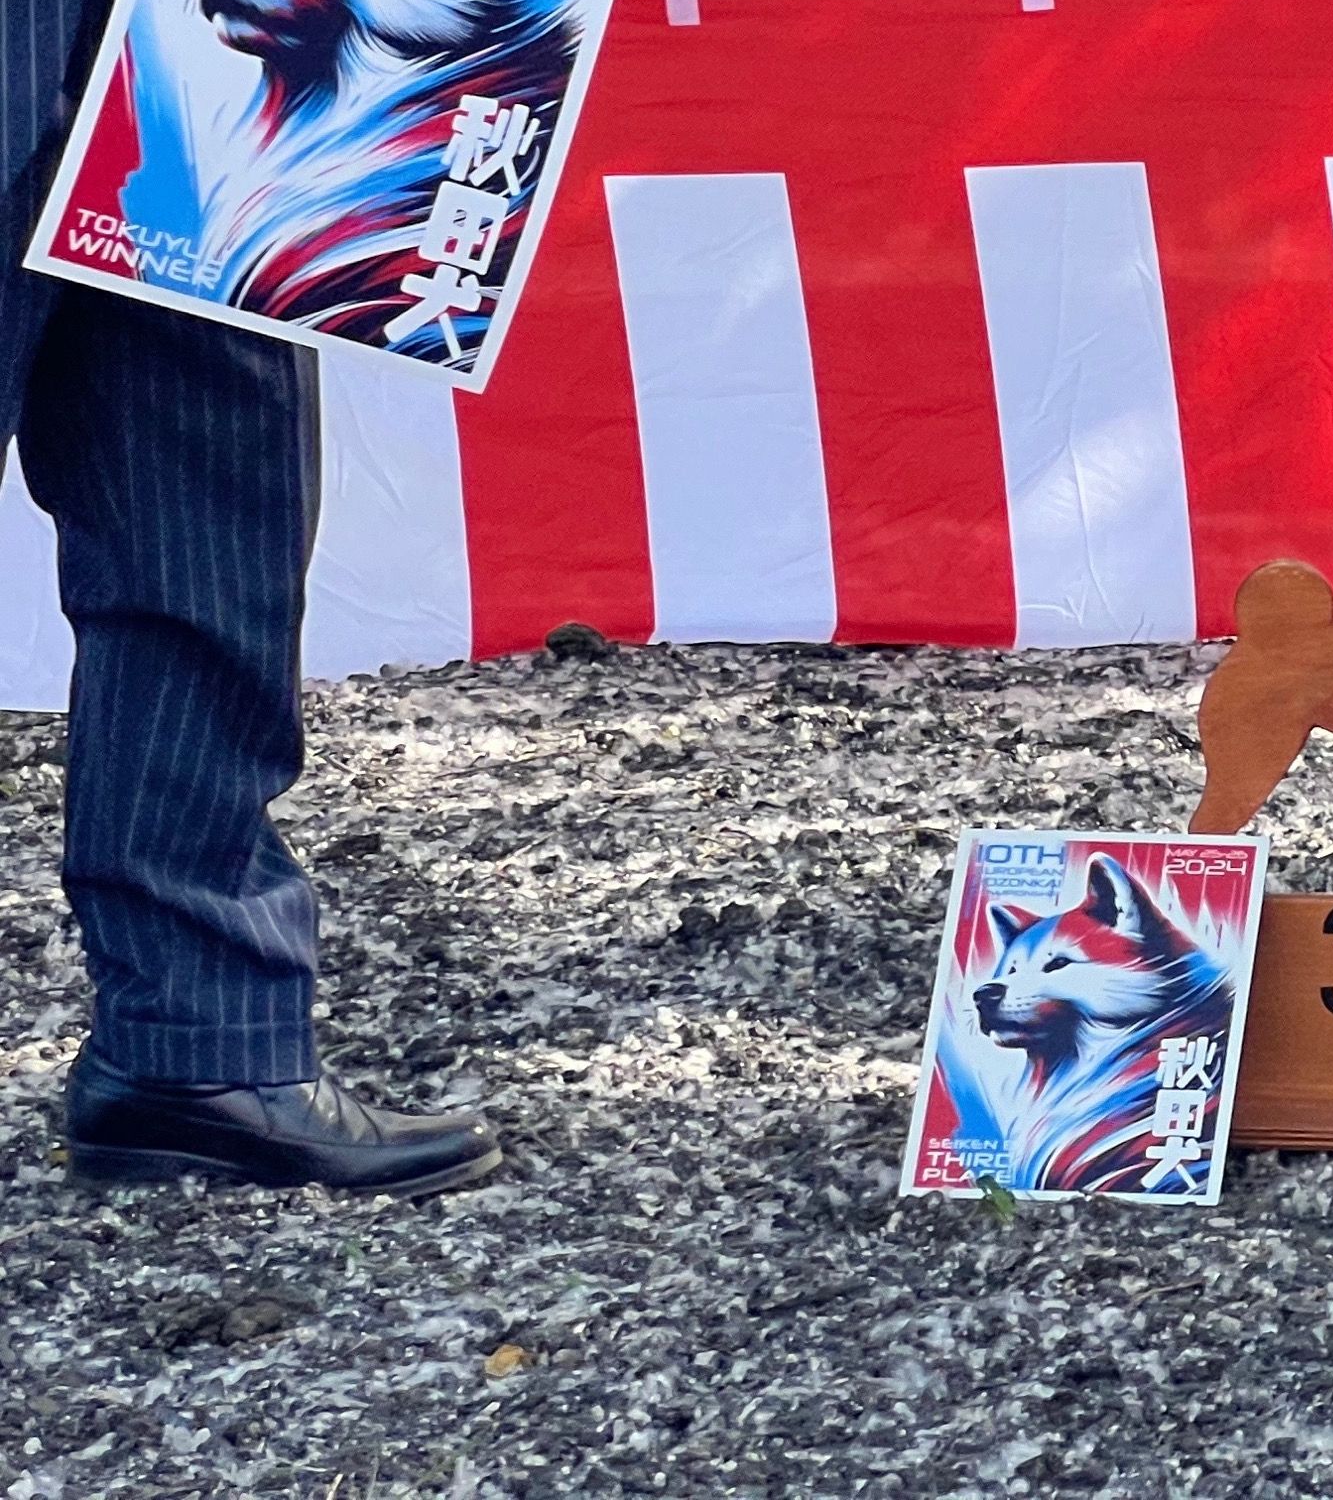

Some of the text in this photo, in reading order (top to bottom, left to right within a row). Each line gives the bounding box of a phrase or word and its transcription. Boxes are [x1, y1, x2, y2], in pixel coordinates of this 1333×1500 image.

[68, 228, 222, 290] WINNER
[384, 93, 541, 360] 秋田犬
[1165, 858, 1247, 876] 2024
[1140, 1036, 1218, 1190] 秋田犬
